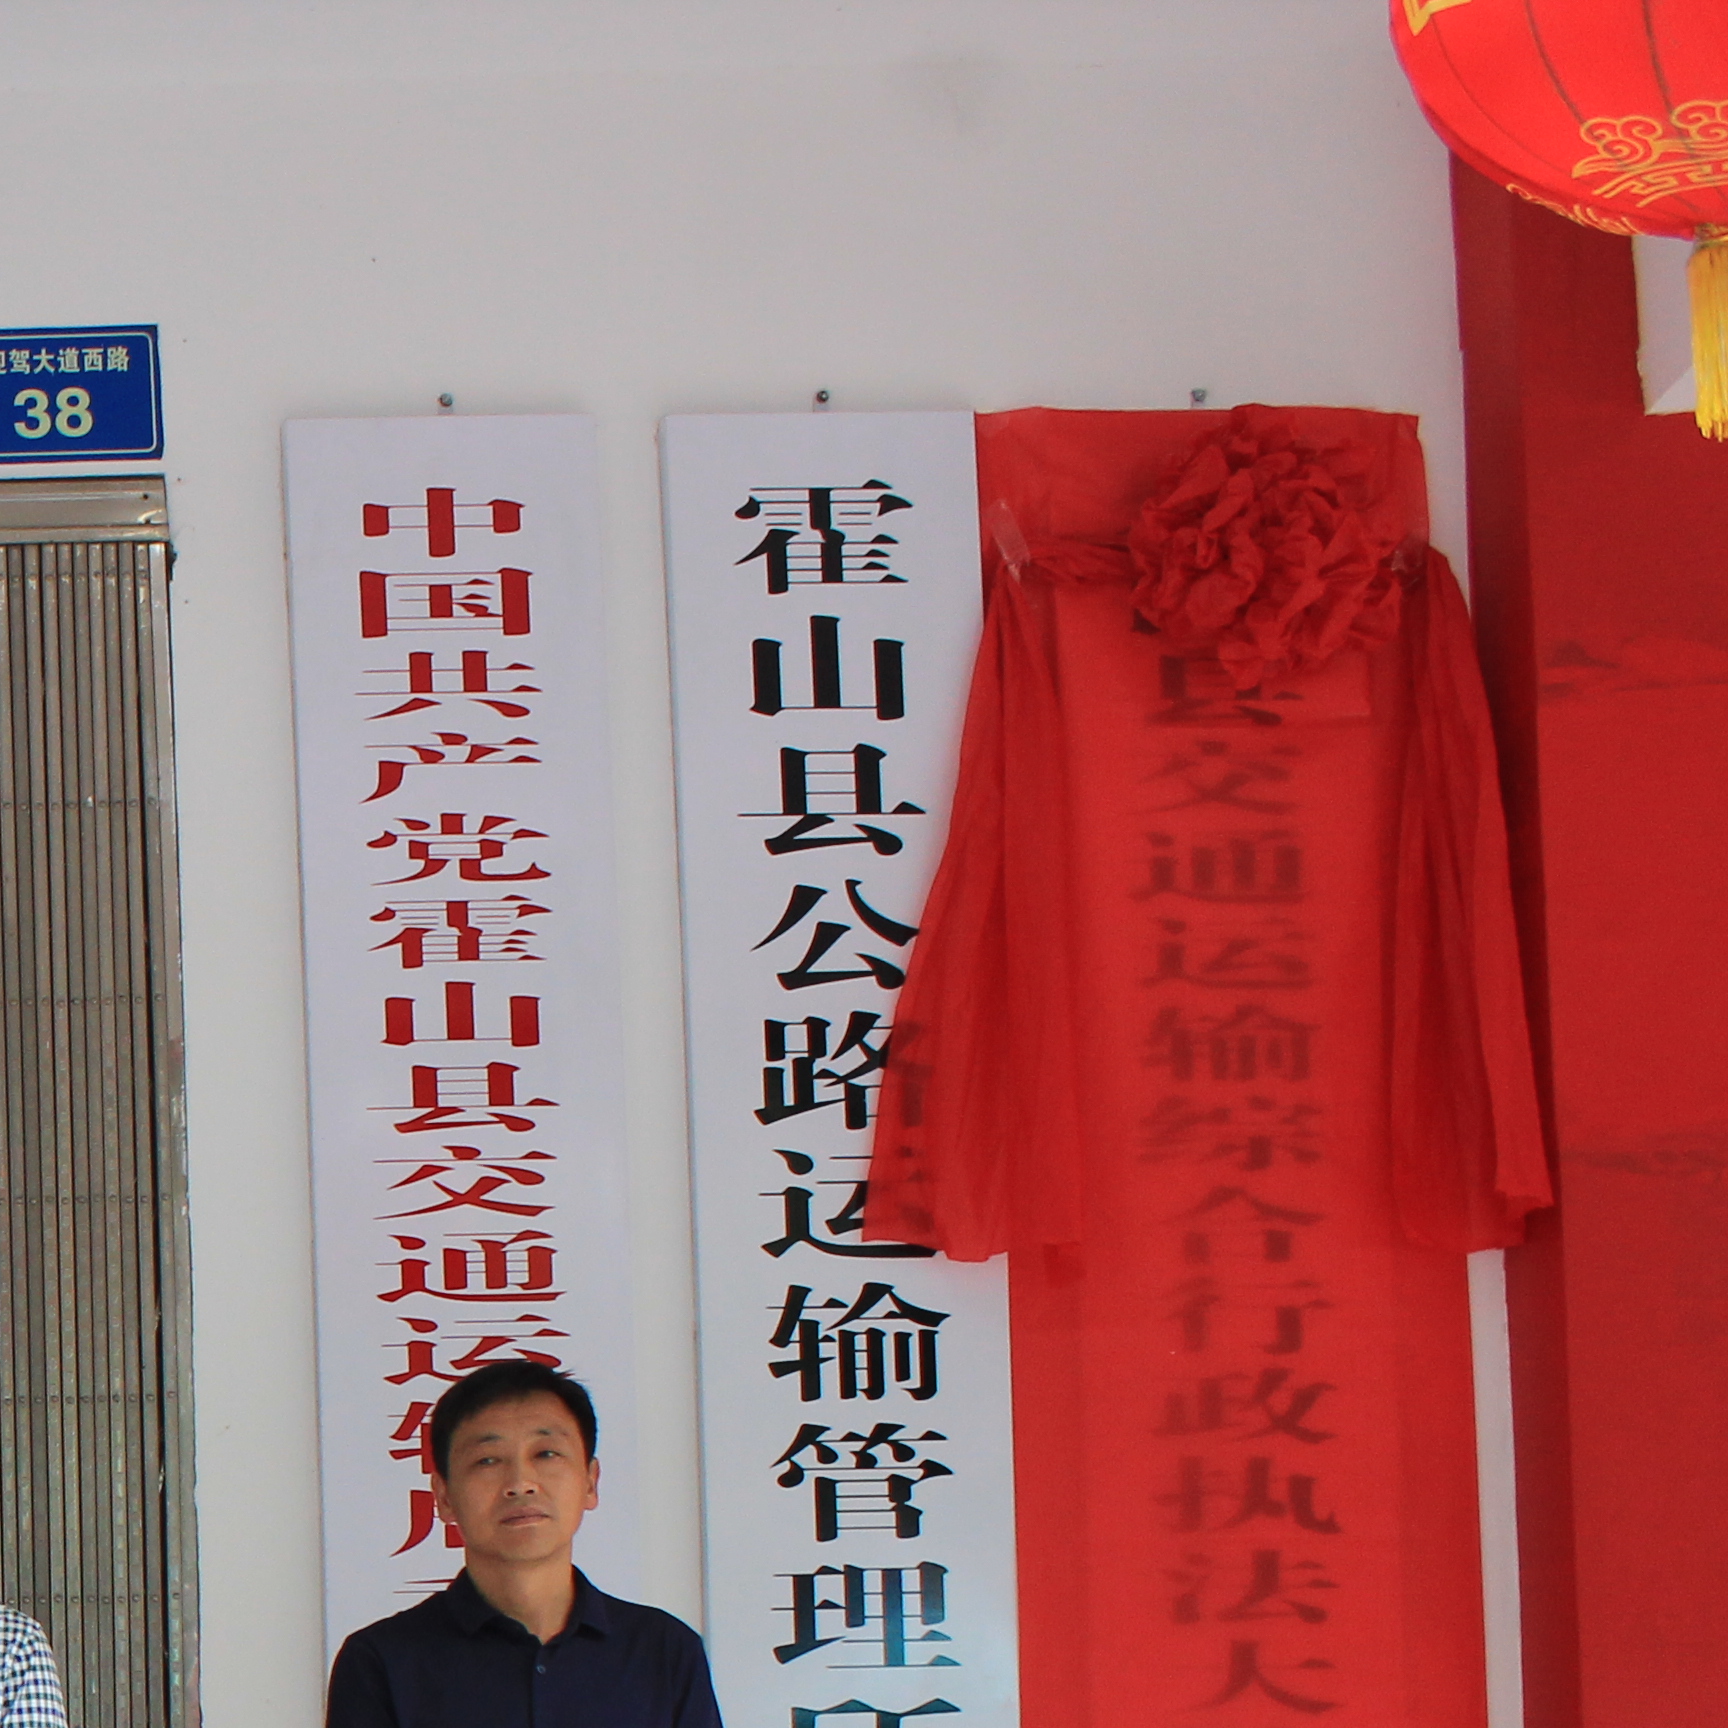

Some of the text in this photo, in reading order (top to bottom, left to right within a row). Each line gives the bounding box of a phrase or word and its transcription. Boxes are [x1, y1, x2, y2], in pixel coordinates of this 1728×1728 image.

[12, 386, 94, 440] 38
[359, 486, 572, 1594] 中国共产党霍山县交通运
